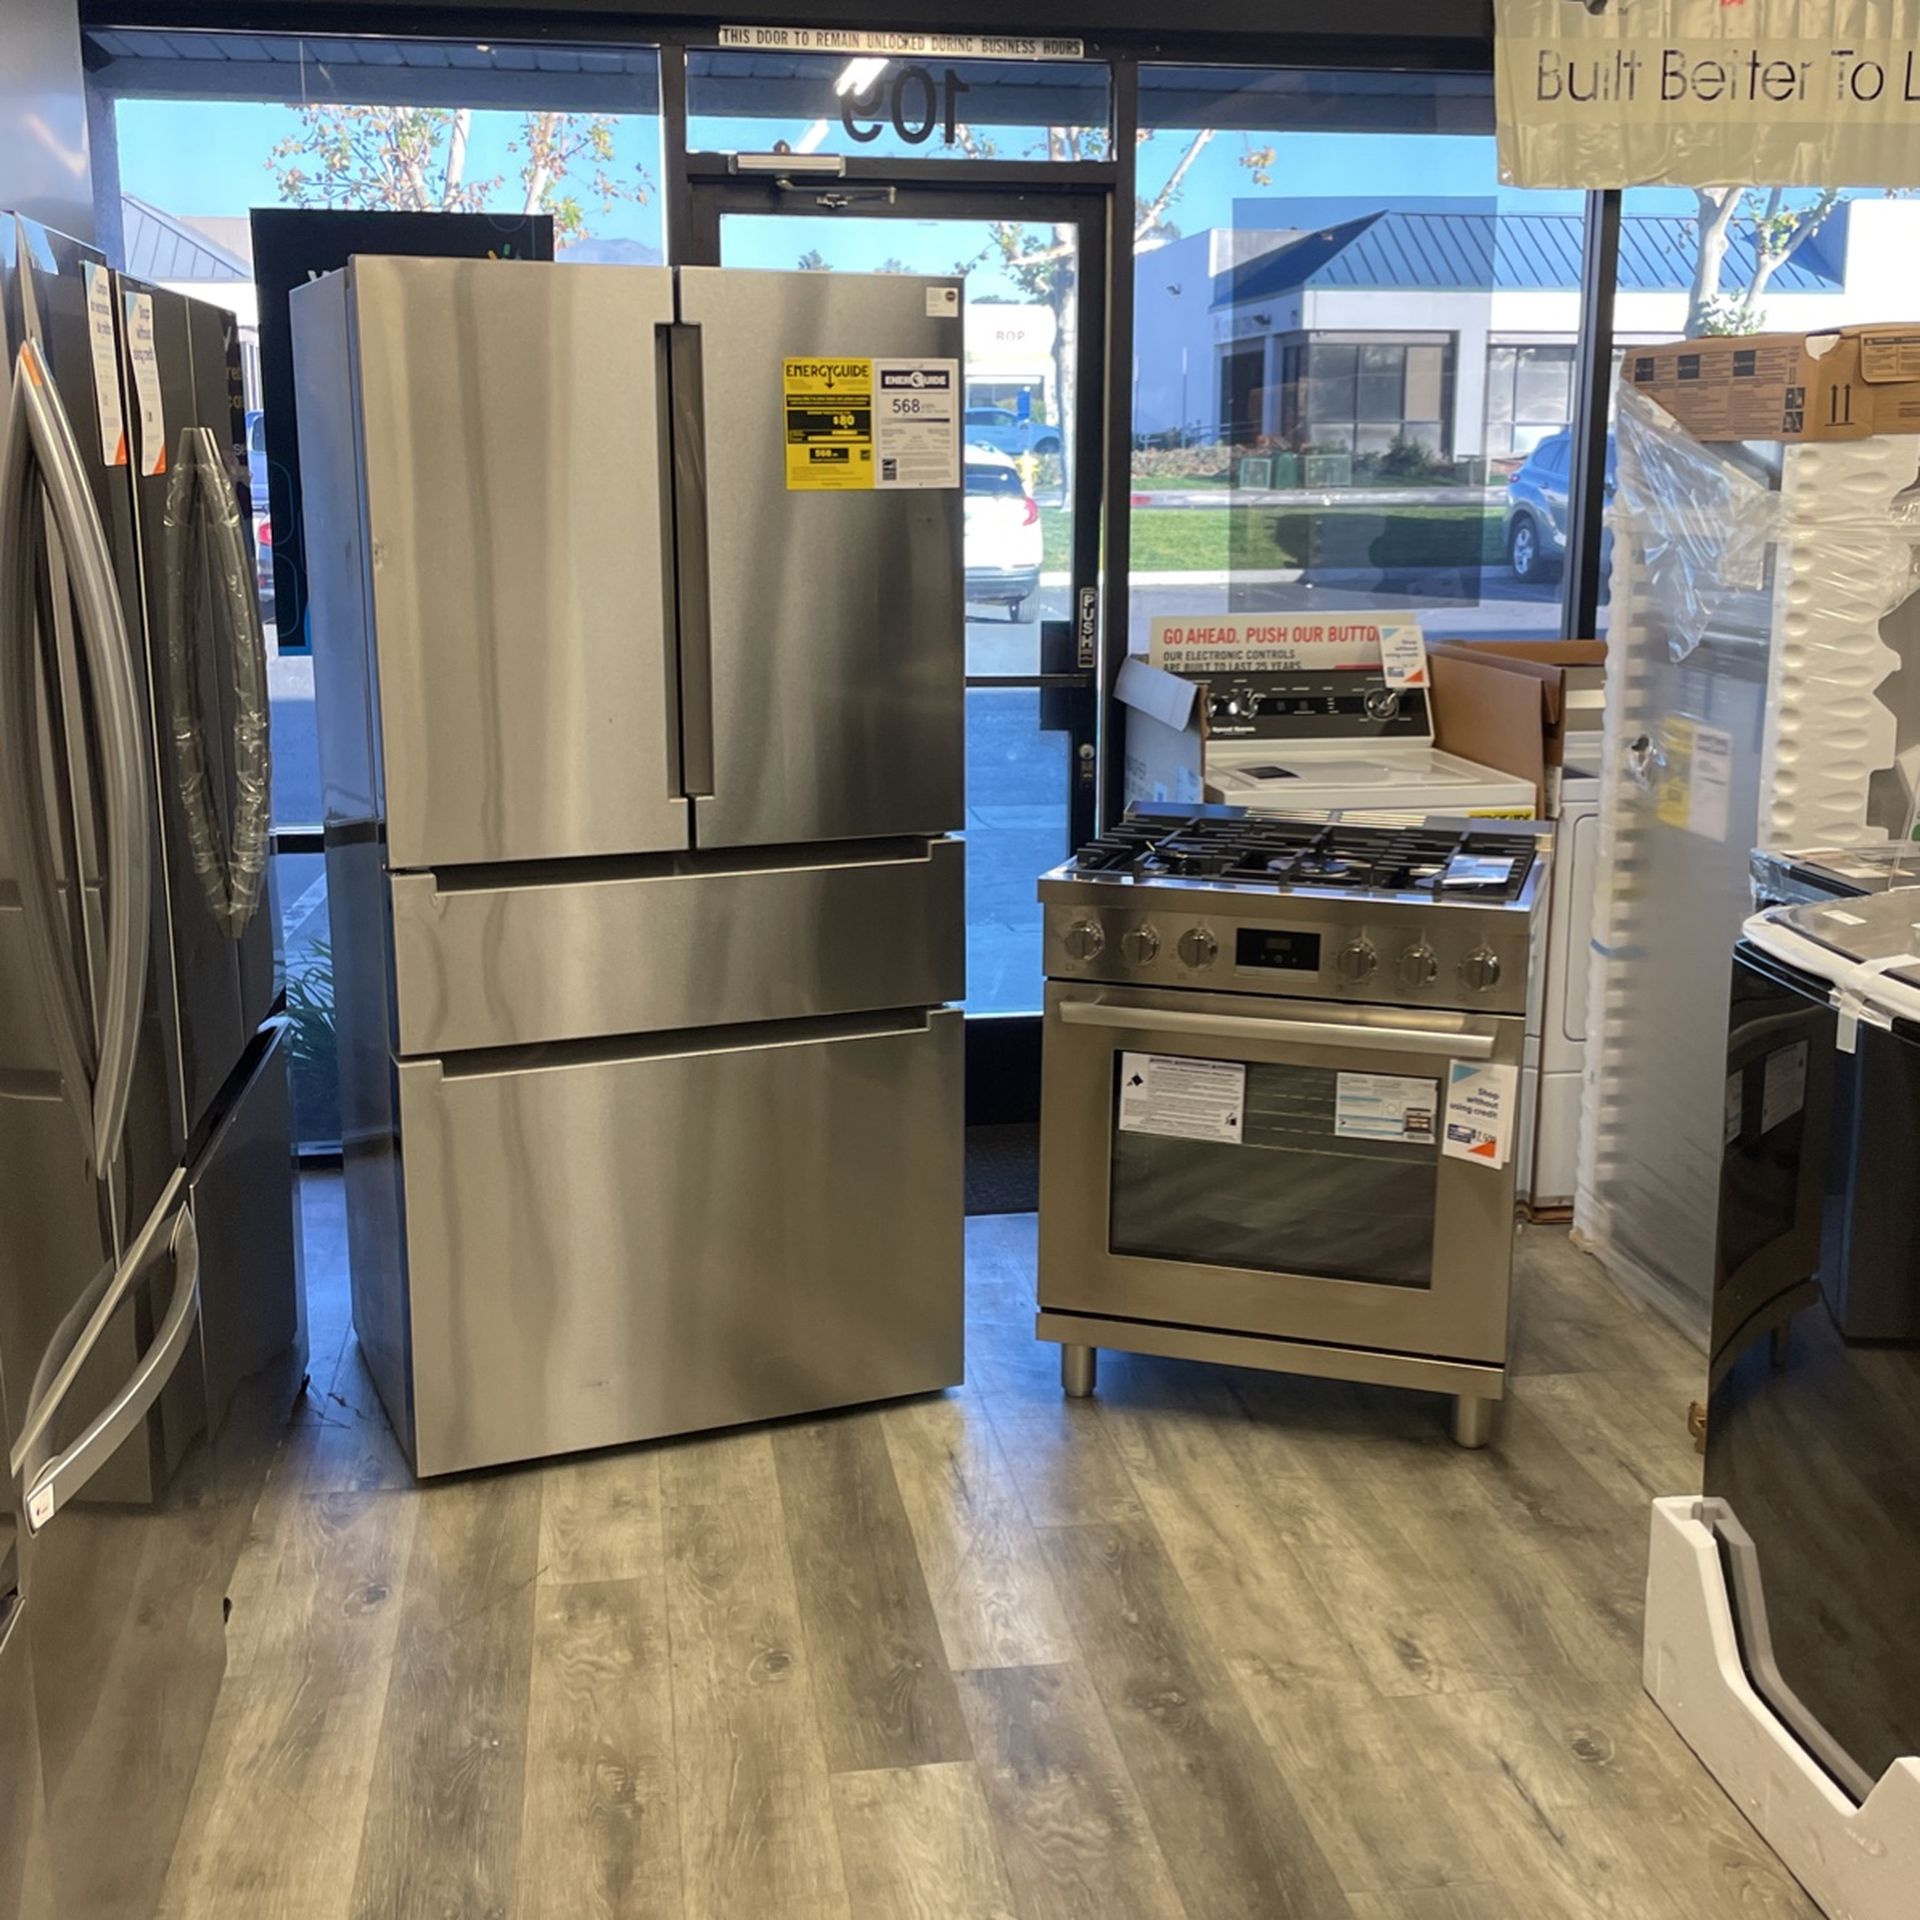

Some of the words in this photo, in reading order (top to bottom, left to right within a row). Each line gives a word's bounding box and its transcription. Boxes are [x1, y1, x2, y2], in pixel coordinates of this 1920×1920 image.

[723, 28, 750, 44] THIS
[756, 29, 789, 45] DOOR
[795, 31, 810, 46] TO
[816, 31, 860, 48] REMAIN
[867, 33, 925, 51] UNLOCKED
[931, 35, 972, 52] DURING
[981, 37, 1036, 54] BUSINESS
[1043, 39, 1081, 56] HOURS
[1536, 49, 1642, 102] Built
[1830, 50, 1884, 101] To
[786, 364, 869, 378] ENERGYGUIDE
[892, 398, 921, 414] 568
[1082, 594, 1095, 648] PUSH
[1163, 628, 1184, 646] GO
[1186, 627, 1240, 645] AHEAD.
[1246, 626, 1288, 644] PUSH
[1292, 626, 1324, 643] OUR
[1328, 625, 1380, 643] BUTTO
[1163, 650, 1183, 661] OUR
[1185, 650, 1243, 661] ELECTRONIC
[1246, 649, 1295, 660] CONTROLS
[1163, 663, 1180, 672] ARE
[1184, 663, 1210, 672] BUILT
[1214, 663, 1226, 671] TO
[1228, 663, 1253, 671] LAST
[1478, 1088, 1500, 1101] Shop
[1466, 1096, 1499, 1110] without
[1449, 1103, 1472, 1115] using
[1474, 1108, 1498, 1120] credit
